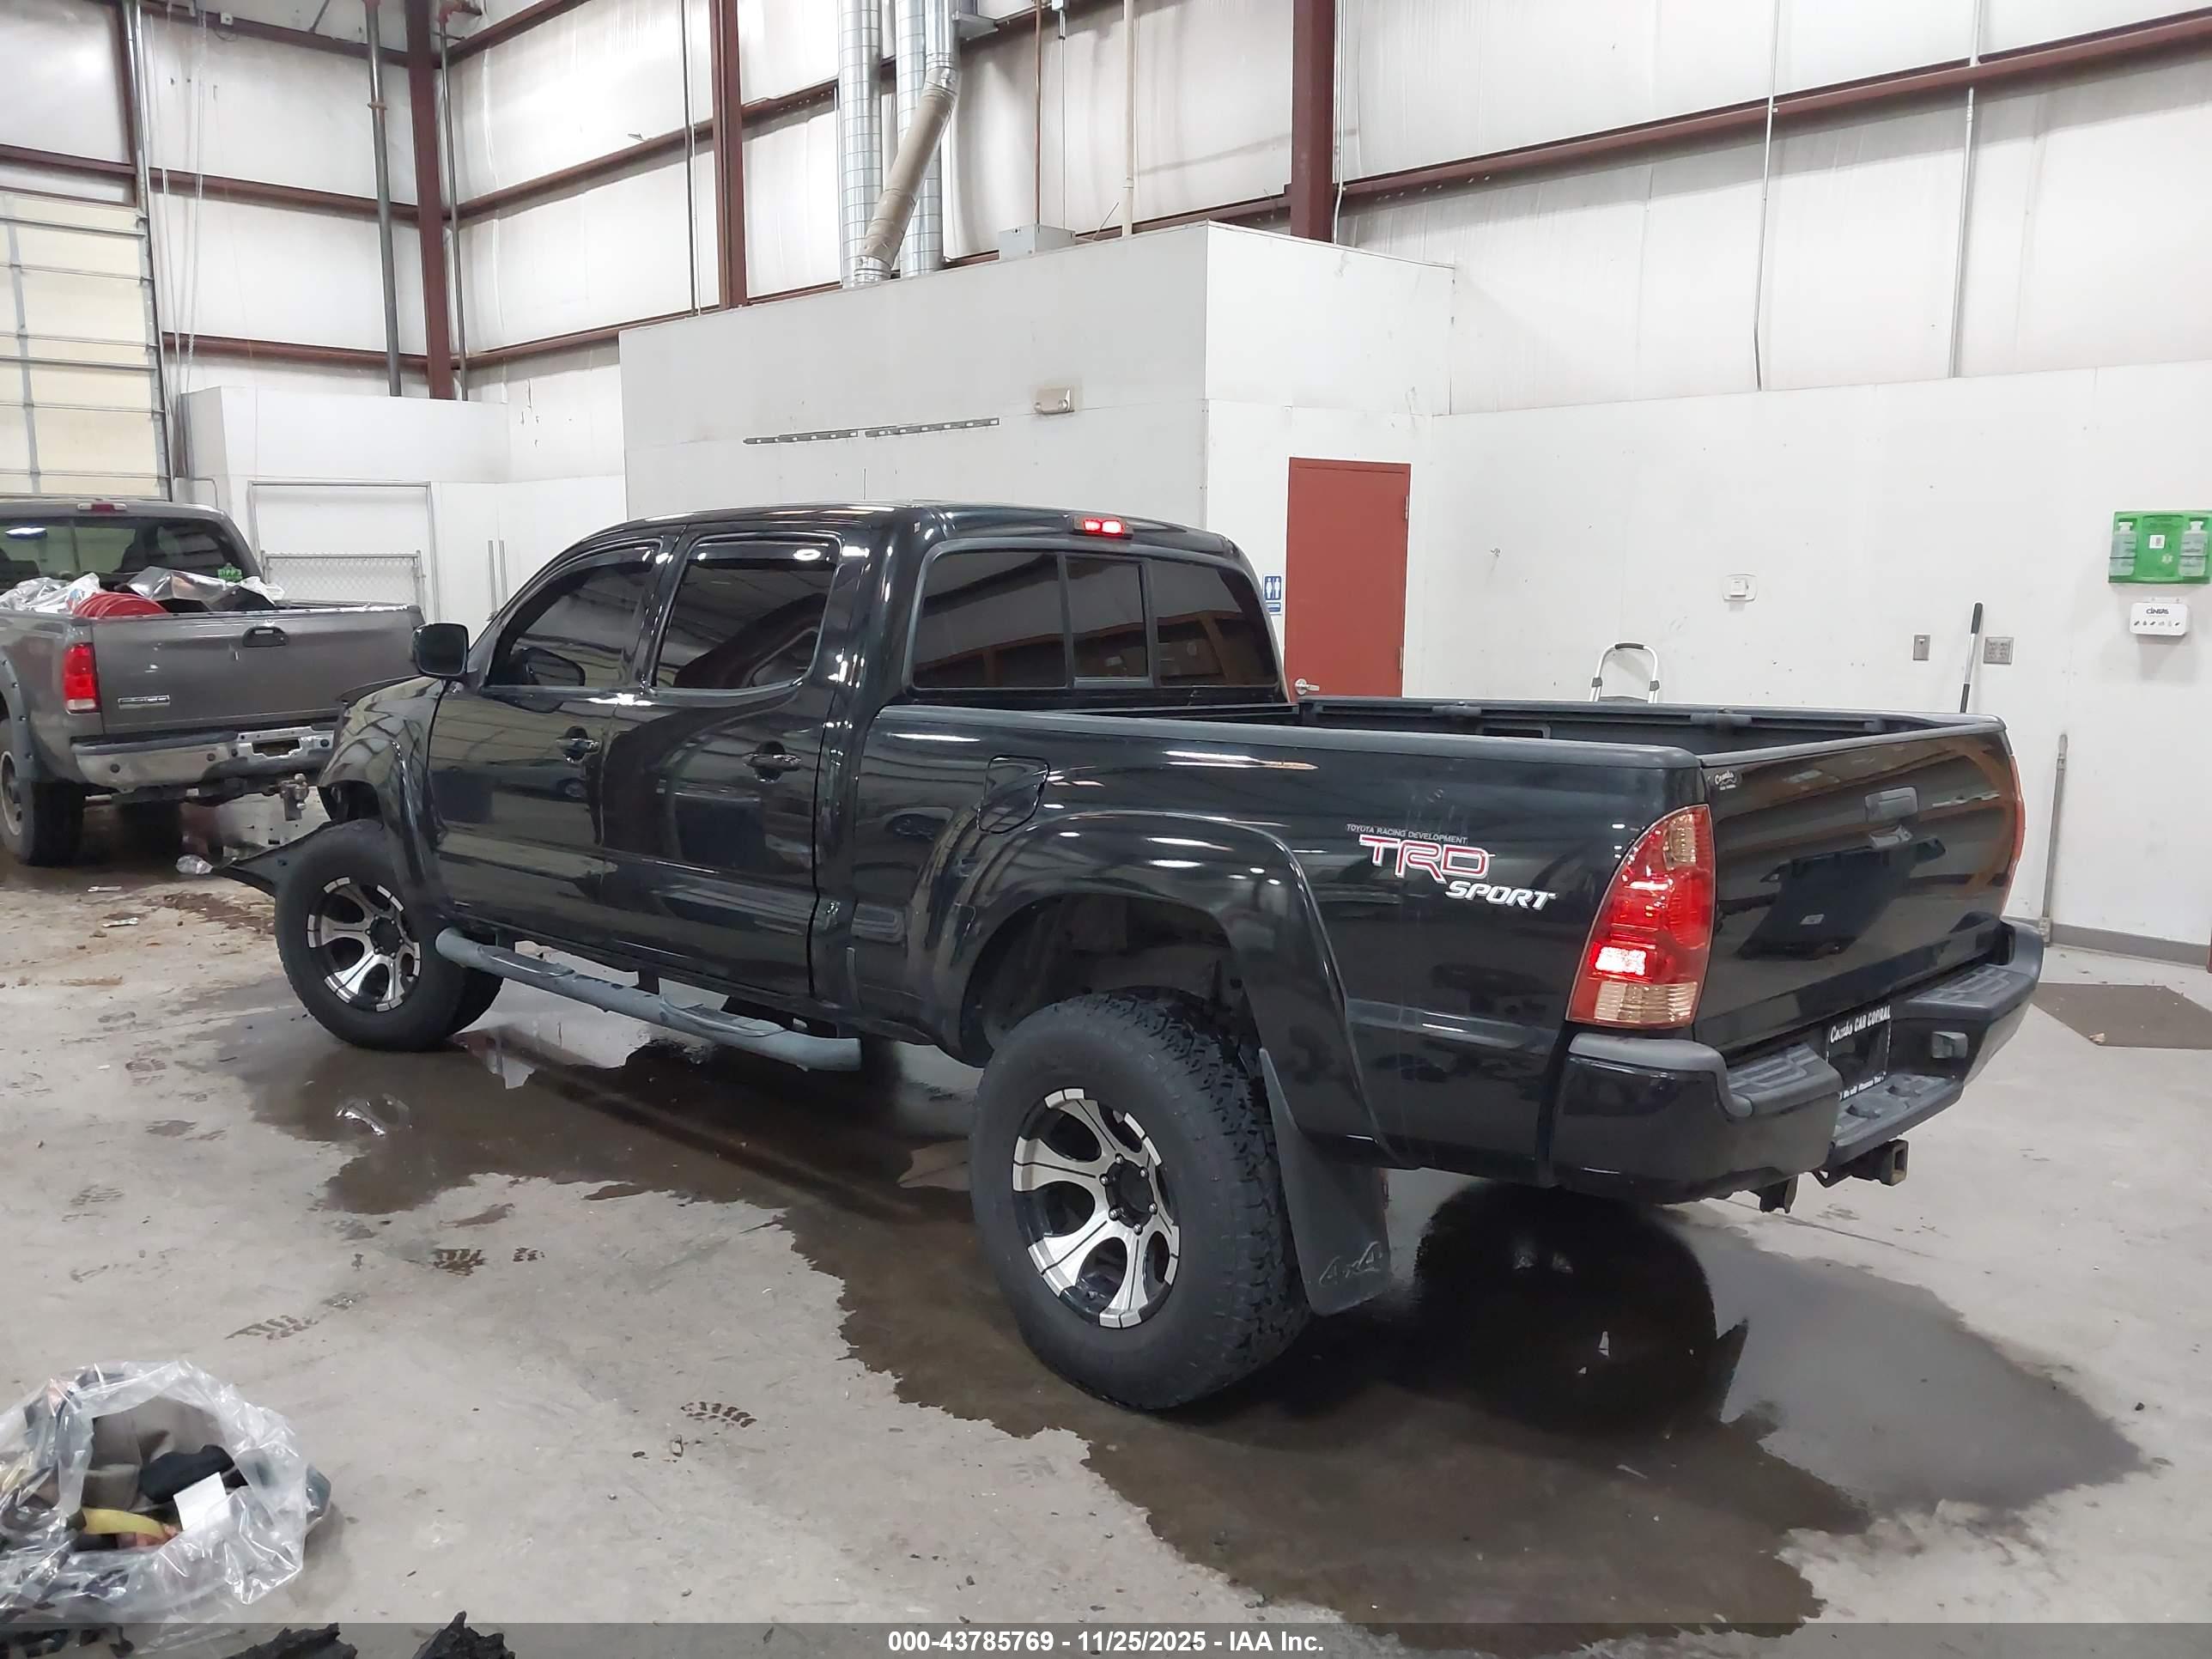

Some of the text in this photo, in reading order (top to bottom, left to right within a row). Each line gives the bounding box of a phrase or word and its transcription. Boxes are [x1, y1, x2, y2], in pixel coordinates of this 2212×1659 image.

[1346, 823, 1468, 845] TOYOTA RACING DEVELOPMENT
[1359, 834, 1495, 884] TRD
[1444, 880, 1559, 910] SPORT
[1854, 1014, 1867, 1032] CAR
[1868, 1005, 1891, 1027] CORRAL
